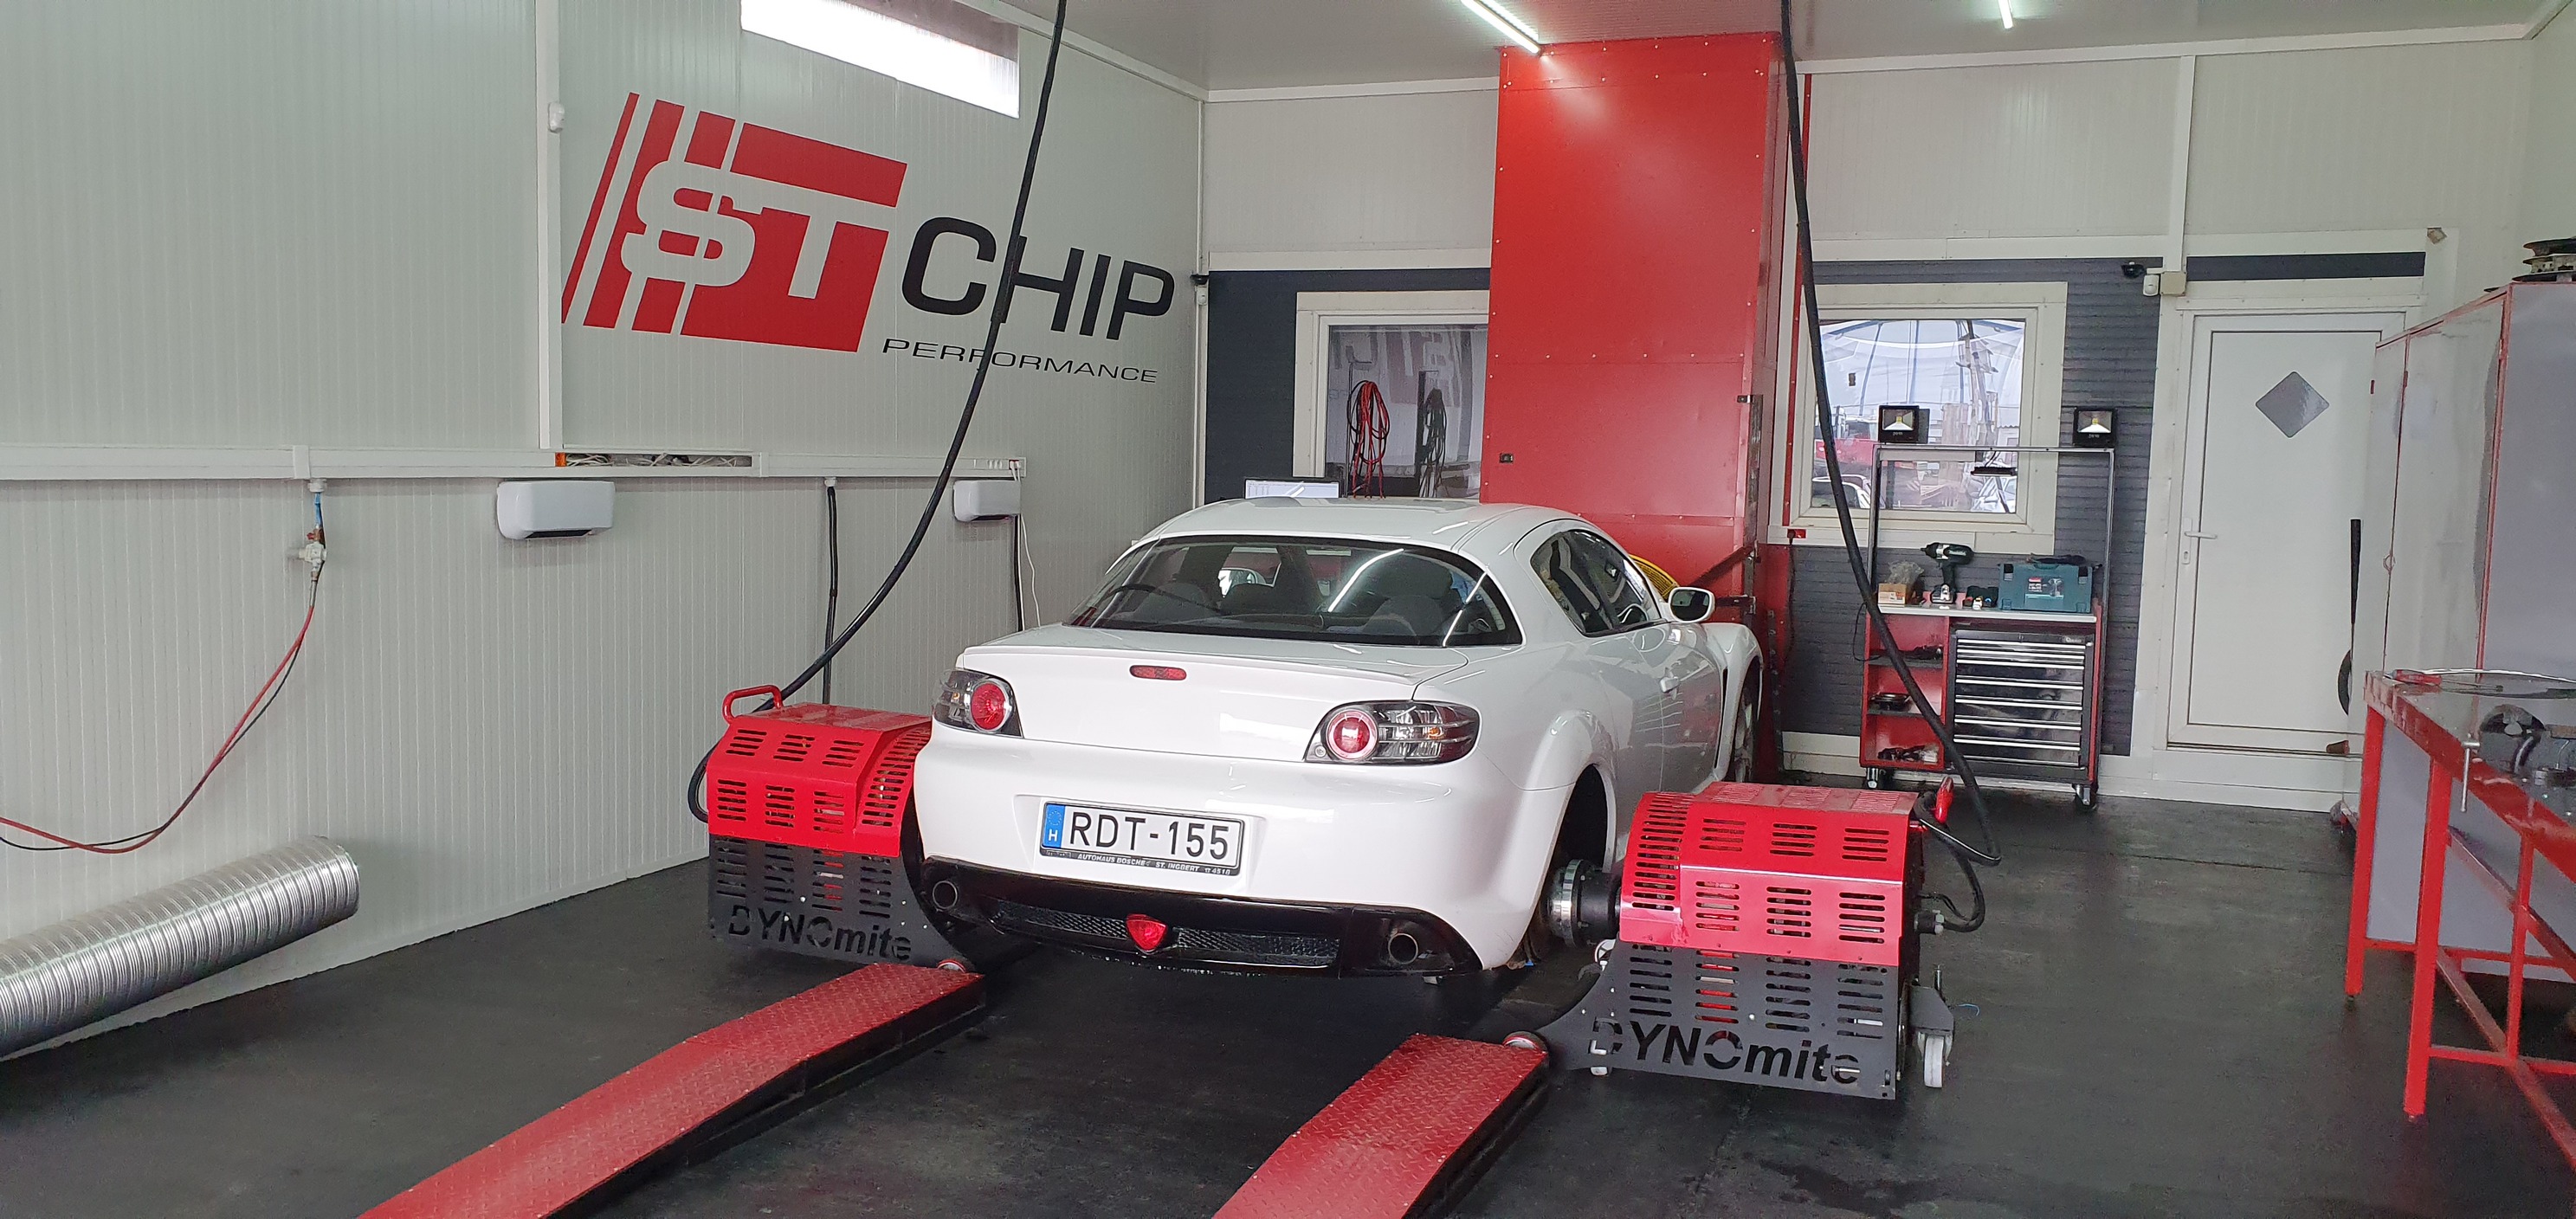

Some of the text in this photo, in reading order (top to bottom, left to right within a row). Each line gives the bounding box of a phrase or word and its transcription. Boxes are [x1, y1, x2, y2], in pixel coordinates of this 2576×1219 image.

[621, 158, 1175, 340] ST CHIP
[881, 339, 1158, 383] PERFORMANCE
[1048, 829, 1058, 842] H
[1069, 811, 1229, 860] RDT-155
[1077, 853, 1115, 863] AUTOHAUS
